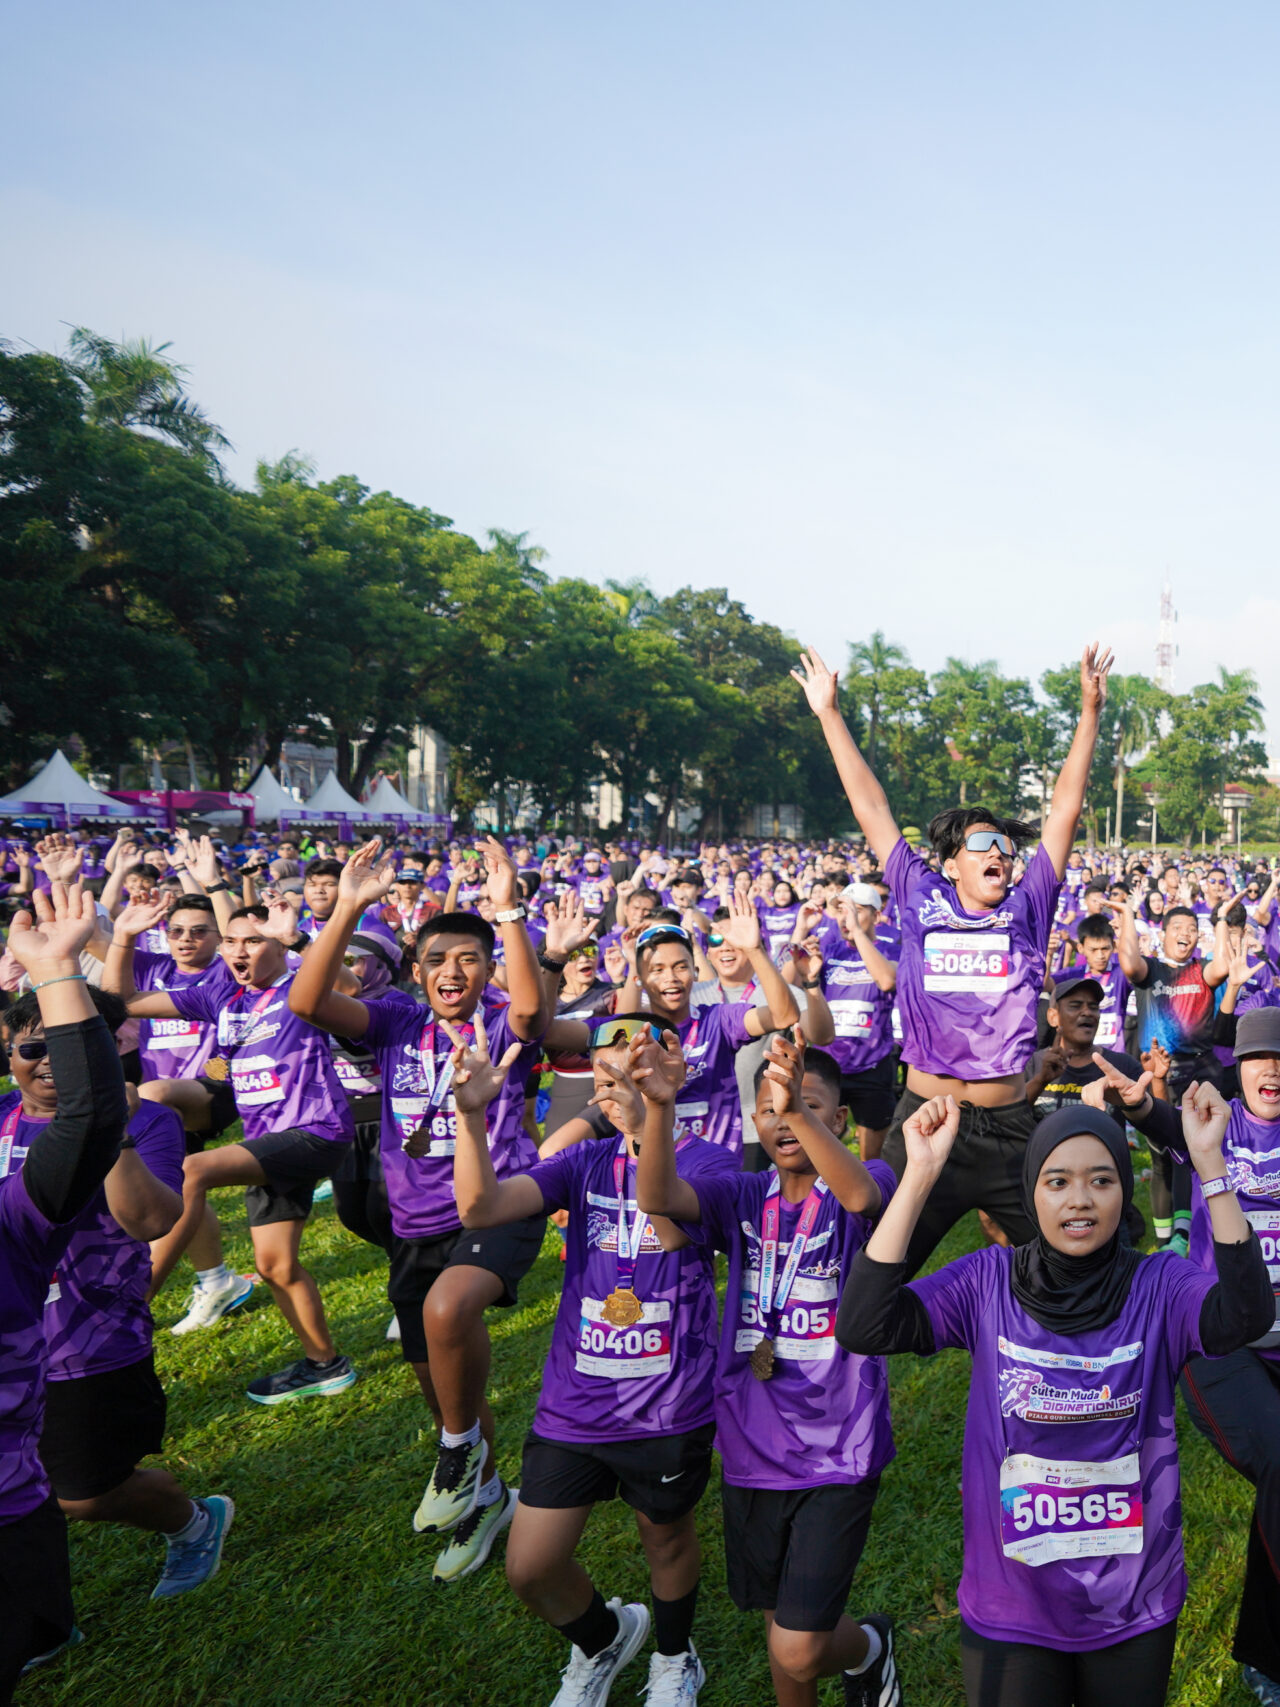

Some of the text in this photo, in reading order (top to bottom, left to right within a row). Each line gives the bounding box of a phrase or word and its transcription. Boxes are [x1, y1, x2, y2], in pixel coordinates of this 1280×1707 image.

[930, 953, 1002, 974] 50846
[580, 1324, 662, 1355] 50406
[1030, 1384, 1100, 1401] Sultan Muda
[1042, 1390, 1143, 1412] DIGINATION RUN
[1028, 1412, 1049, 1420] PIALA
[1013, 1491, 1131, 1532] 50565
